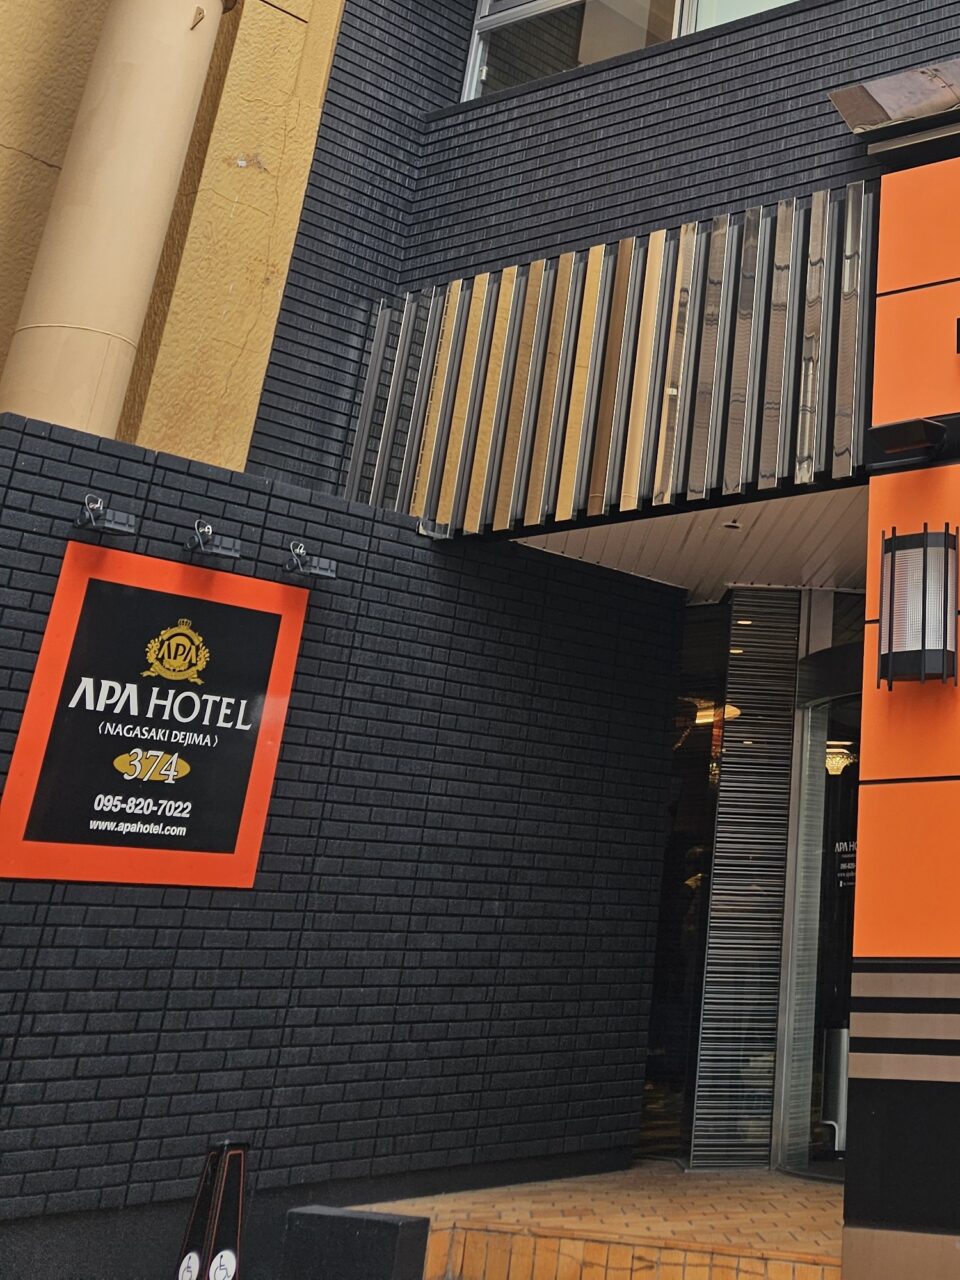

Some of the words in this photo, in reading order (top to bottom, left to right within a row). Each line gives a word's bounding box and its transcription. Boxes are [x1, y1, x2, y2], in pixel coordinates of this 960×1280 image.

[158, 640, 197, 664] APA
[68, 676, 139, 717] APA
[146, 686, 252, 731] HOTEL
[123, 747, 180, 784] 374
[93, 793, 192, 818] 095-820-7022
[89, 819, 188, 837] www.apahotel.com
